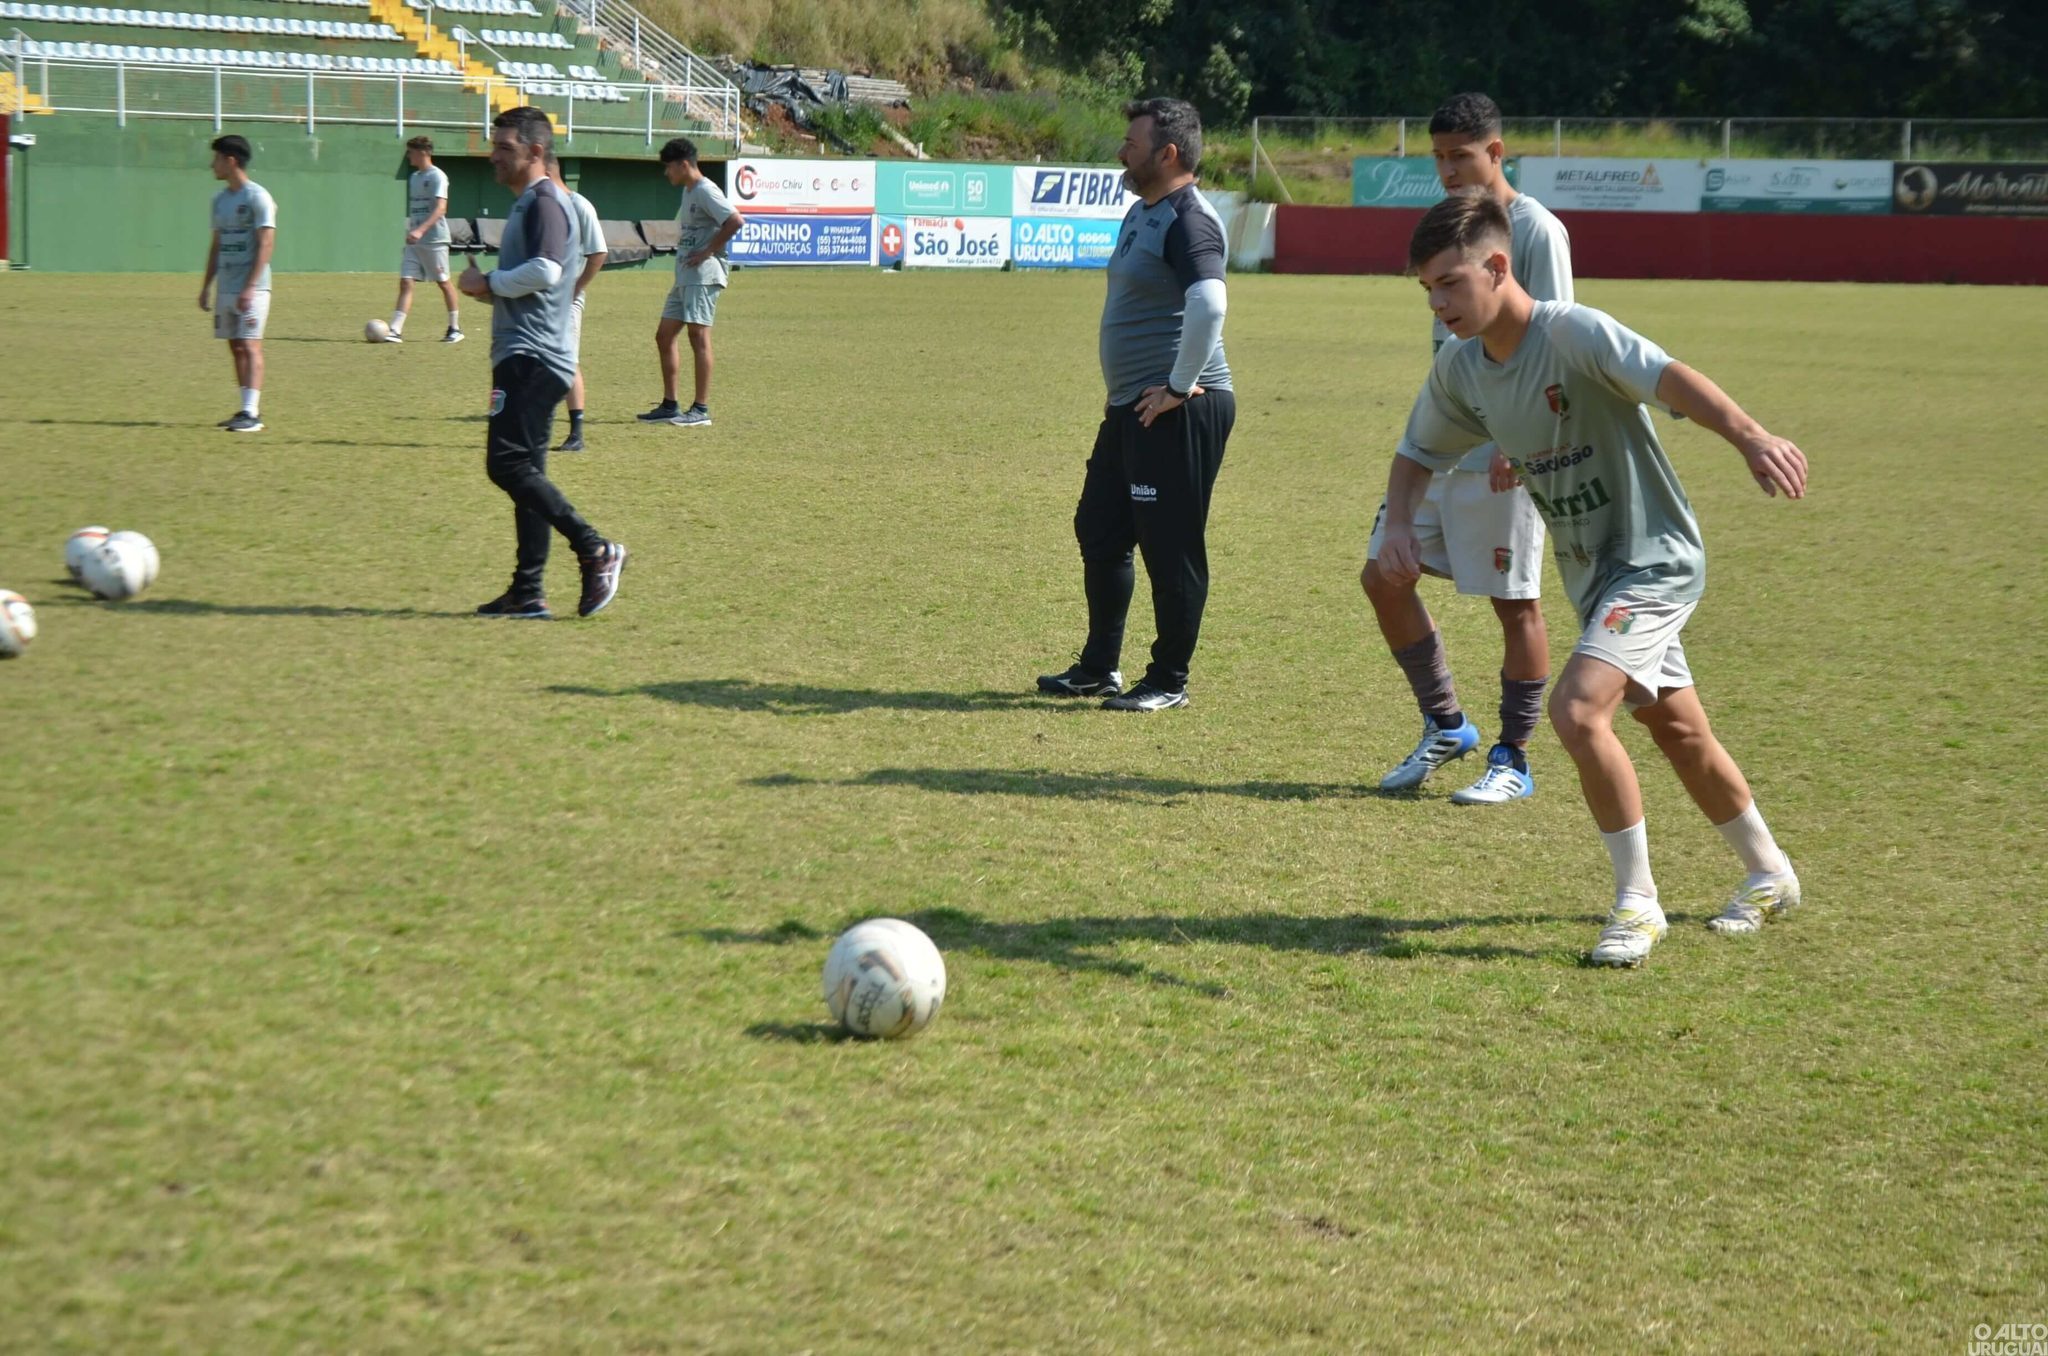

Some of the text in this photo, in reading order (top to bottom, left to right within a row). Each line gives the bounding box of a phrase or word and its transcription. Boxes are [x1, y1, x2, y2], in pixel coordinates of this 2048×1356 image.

[1556, 170, 1641, 182] METALFRED
[755, 179, 780, 190] Grupo
[967, 179, 984, 195] 50
[1066, 172, 1124, 206] FIBRA
[1020, 222, 1033, 243] O
[1033, 223, 1074, 244] ALTO
[760, 242, 812, 256] AUTOPEÇAS
[914, 231, 949, 256] São
[956, 232, 999, 256] José
[1014, 243, 1074, 263] URUGUAI
[1130, 483, 1157, 496] União
